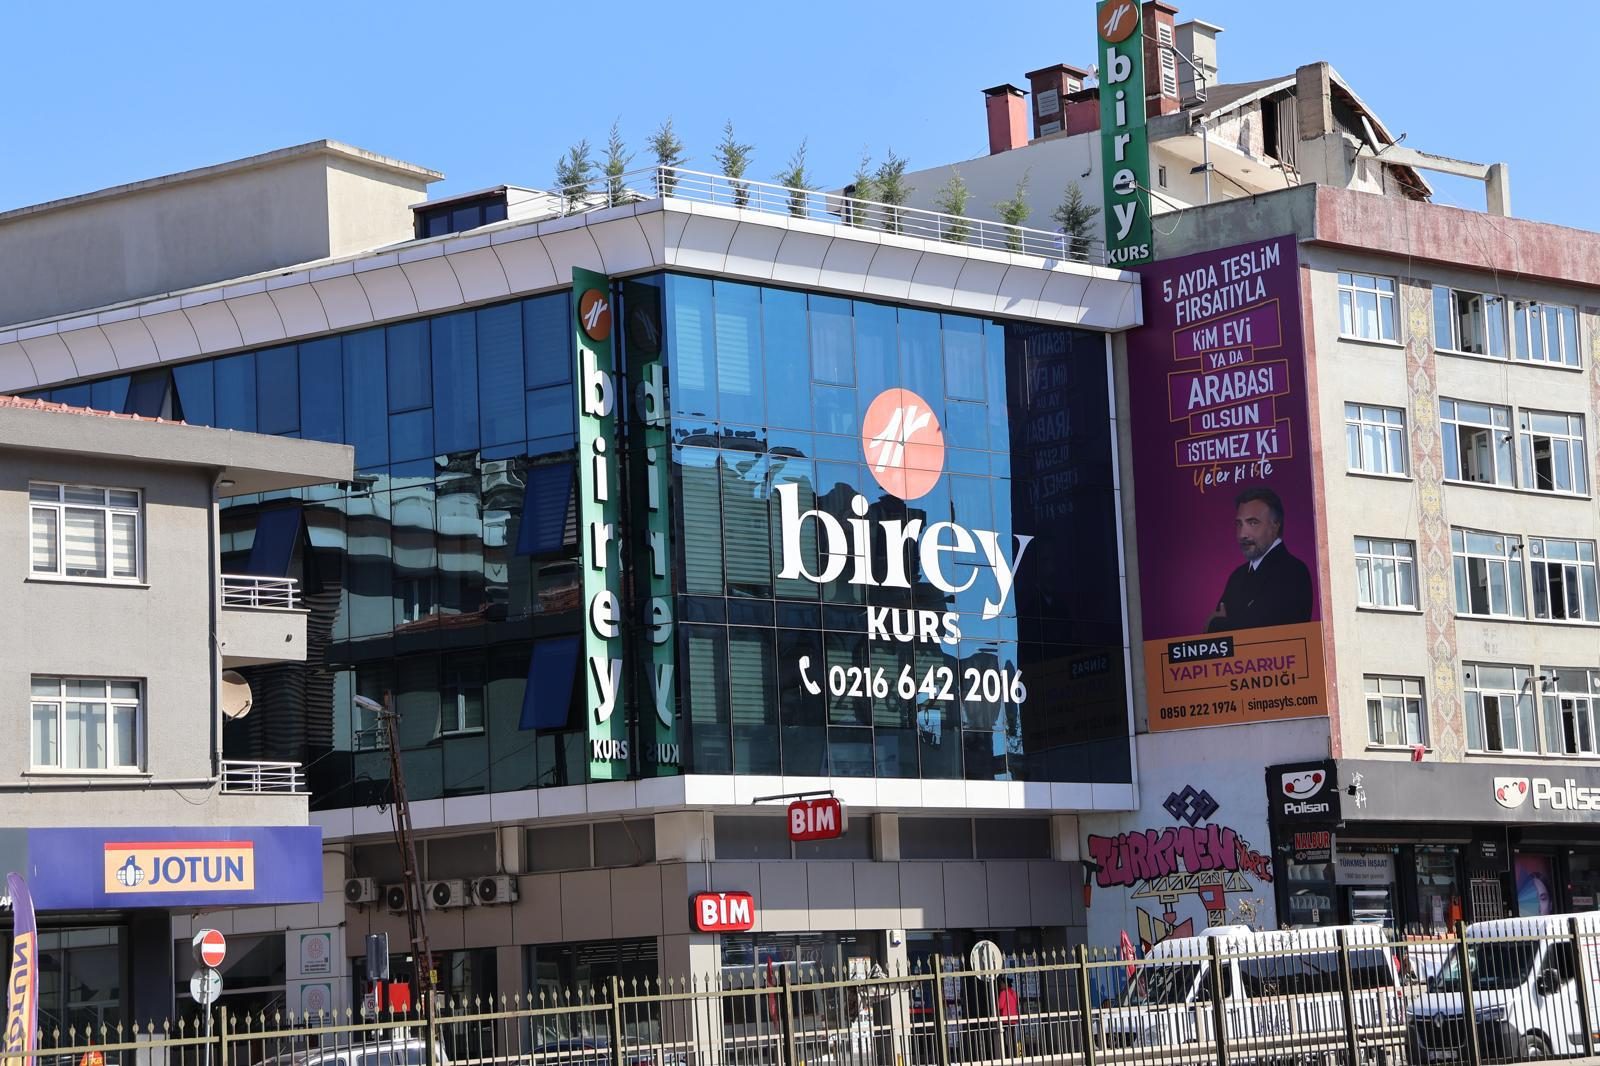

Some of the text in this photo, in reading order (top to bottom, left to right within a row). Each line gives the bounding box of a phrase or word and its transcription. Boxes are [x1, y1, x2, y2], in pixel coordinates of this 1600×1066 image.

[1107, 47, 1138, 241] birey
[1107, 244, 1149, 265] KURS
[1163, 243, 1281, 303] 5 AYDA TESLİM
[1175, 276, 1266, 326] FIRSATIYLA
[1192, 317, 1252, 352] KİM EVİ
[1209, 350, 1244, 368] YA DA
[1188, 367, 1274, 409] ARABASI
[1202, 403, 1259, 429] OLSUN
[1188, 429, 1278, 462] İSTEMEZ Kİ
[1234, 464, 1245, 484] ki
[1250, 453, 1273, 480] iste
[579, 348, 624, 724] birey
[775, 483, 1035, 620] birey
[867, 605, 962, 645] KURS
[1172, 641, 1229, 659] SİNPAŞ
[1170, 654, 1296, 681] YAPI TASARRUF
[1230, 671, 1296, 691] SANDIĞI
[829, 664, 889, 700] 0216
[965, 668, 1027, 704] 2016
[1160, 693, 1318, 720] 0850 222 1974 sinpasyts.com
[592, 737, 629, 762] KURS
[791, 801, 836, 834] BİM
[1284, 801, 1329, 815] Polisan
[1088, 824, 1238, 888] TÜRKMEN
[1294, 831, 1330, 849] NALBUR
[148, 855, 244, 884] JOTUN
[702, 893, 750, 925] BİM
